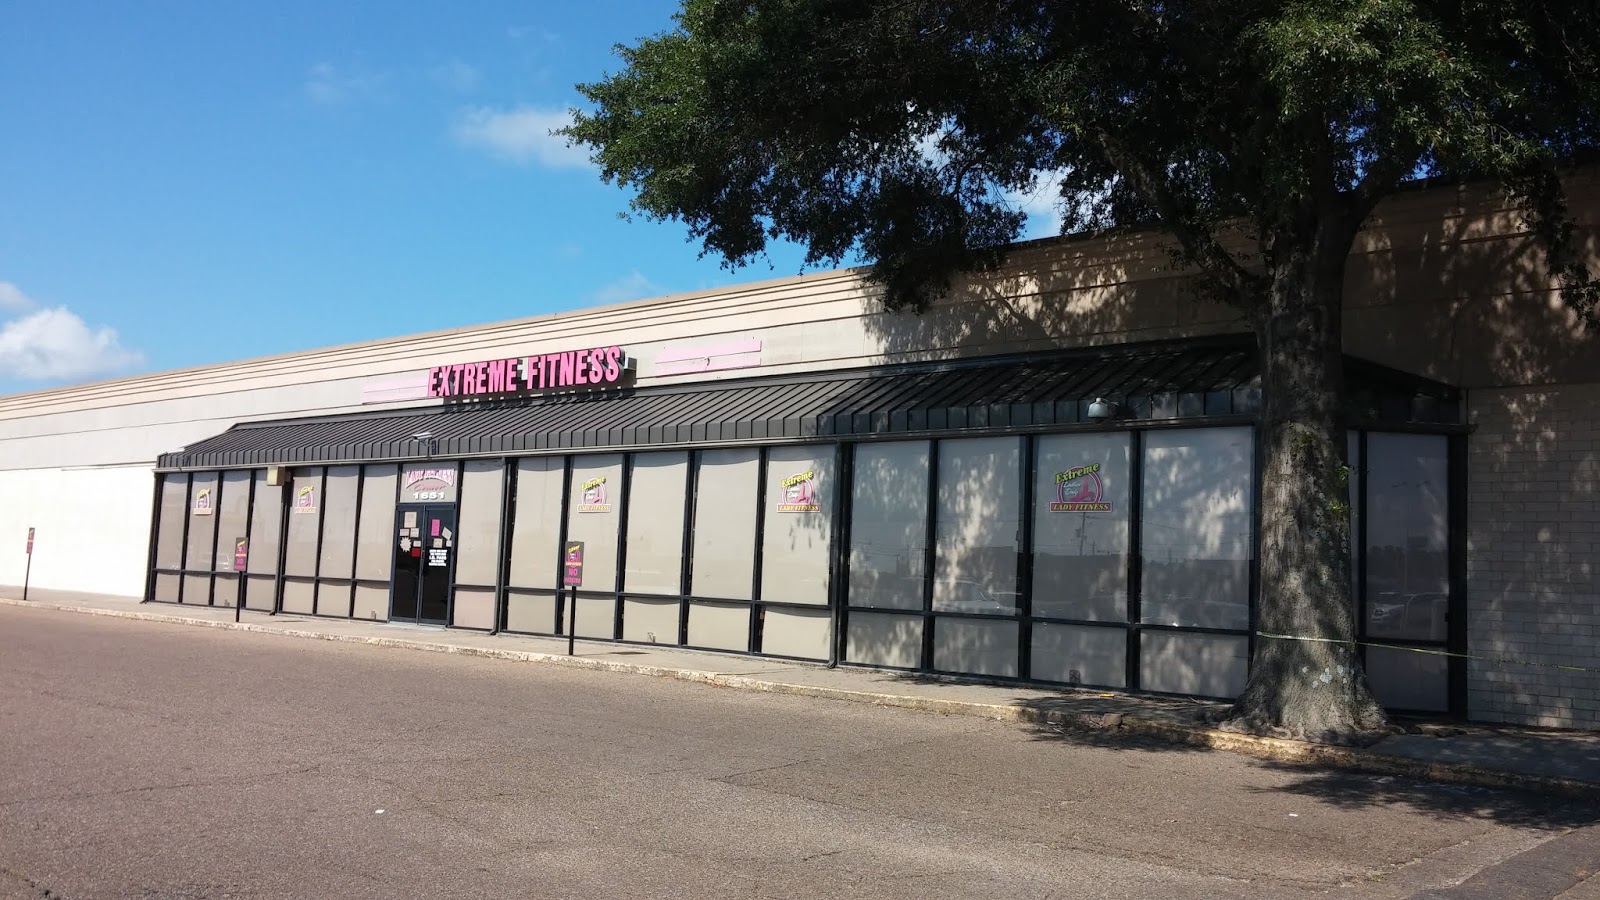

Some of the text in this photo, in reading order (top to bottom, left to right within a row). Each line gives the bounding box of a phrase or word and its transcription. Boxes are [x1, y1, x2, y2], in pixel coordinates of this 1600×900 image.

[428, 345, 623, 397] EXTREME FITNESS
[781, 471, 814, 488] Extreme
[1055, 463, 1100, 484] Extreme
[413, 491, 446, 500] 1651
[1053, 503, 1109, 511] LADY FITNESS
[568, 568, 578, 576] NO
